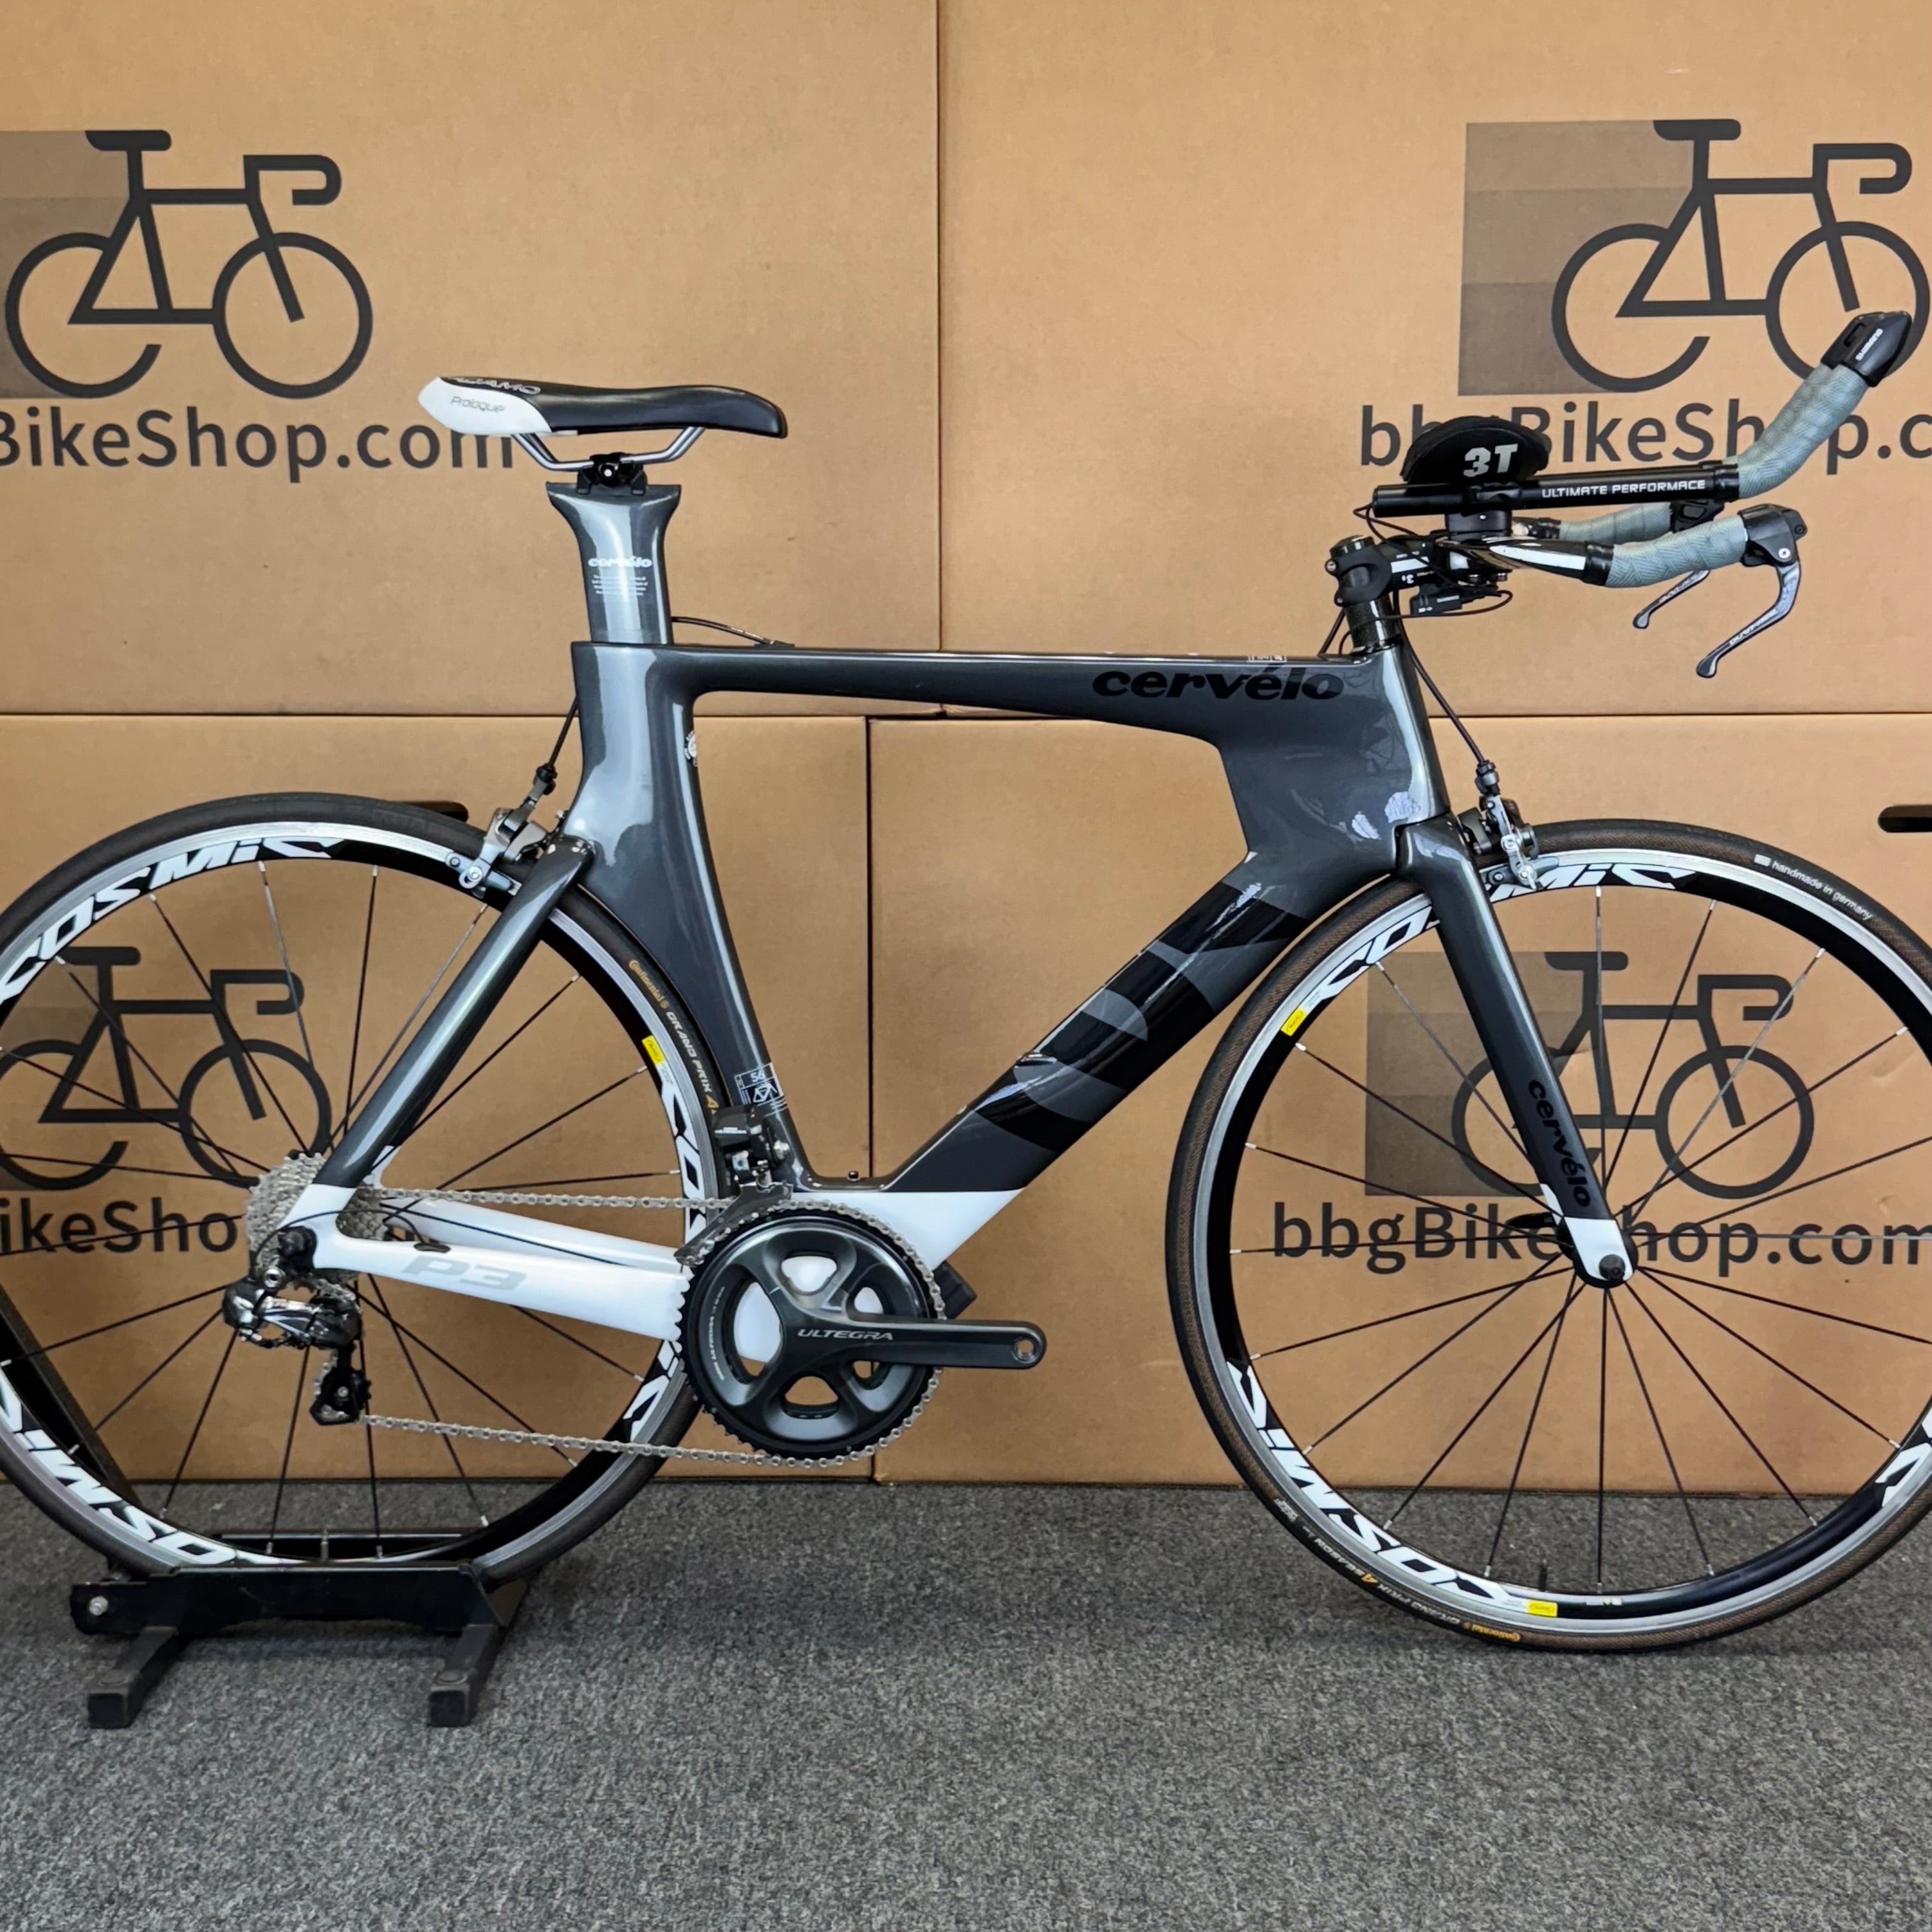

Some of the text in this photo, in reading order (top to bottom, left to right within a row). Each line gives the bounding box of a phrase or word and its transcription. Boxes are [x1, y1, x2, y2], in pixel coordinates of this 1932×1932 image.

[450, 396, 505, 413] Prologue
[1463, 443, 1518, 477] 3T
[1542, 480, 1706, 498] ULTIMATE PERFORMACE
[1092, 663, 1344, 700] cervélo
[1772, 861, 1873, 920] handmade in germany
[666, 1012, 697, 1057] GRAND
[693, 1059, 712, 1092] PRIX
[750, 1069, 766, 1083] 56
[1528, 1080, 1590, 1207] cervélo
[1274, 1202, 1932, 1277] bbgBikehop.com
[402, 1255, 526, 1291] P3
[797, 1329, 893, 1340] ULTEGRA
[1377, 1583, 1411, 1603] PRIX
[1411, 1601, 1460, 1625] GRAND
